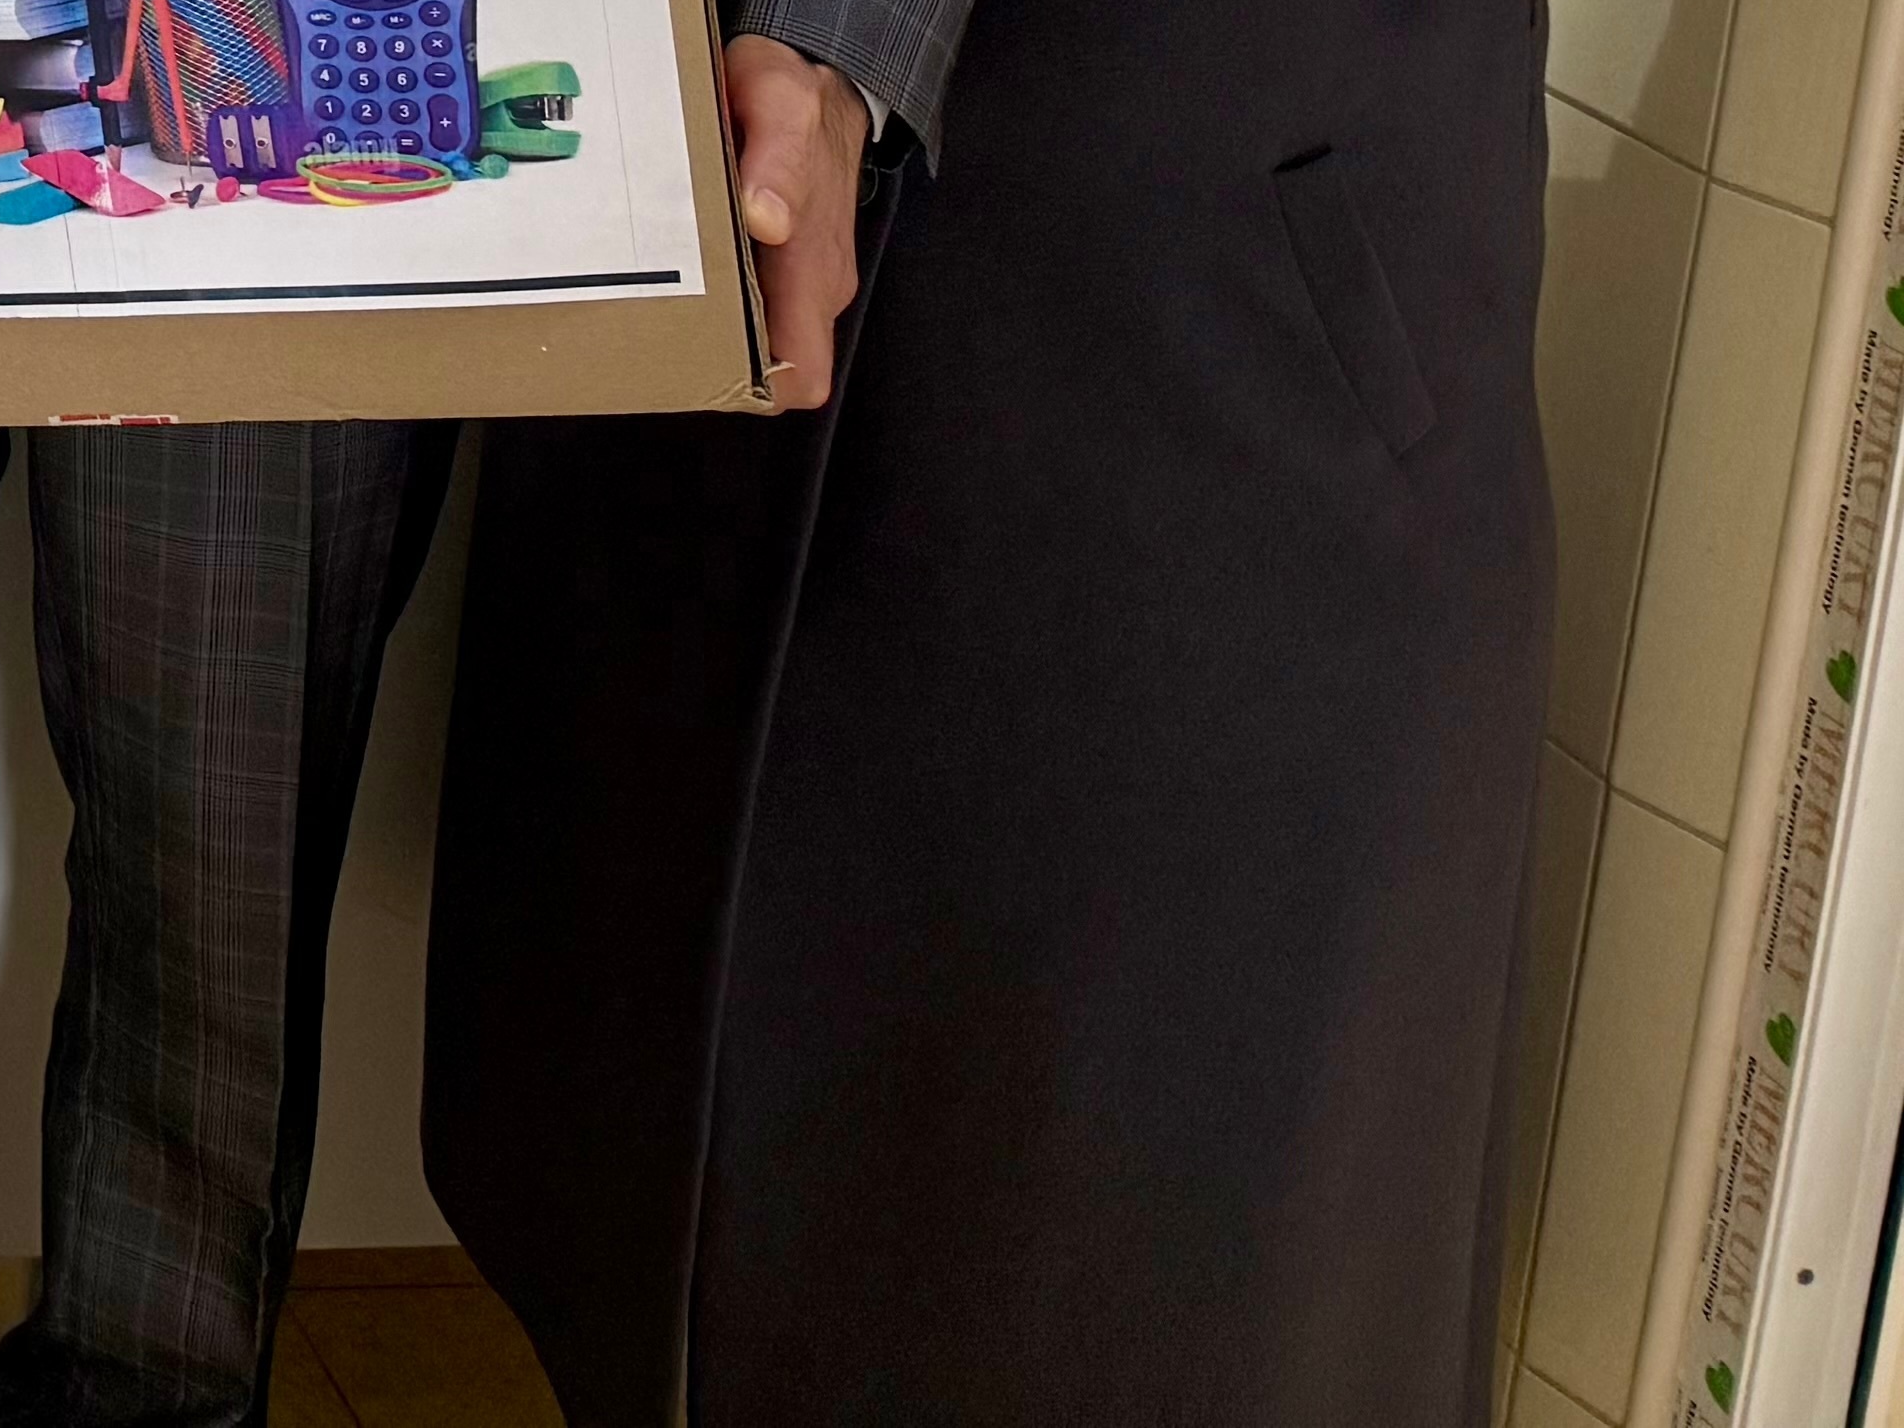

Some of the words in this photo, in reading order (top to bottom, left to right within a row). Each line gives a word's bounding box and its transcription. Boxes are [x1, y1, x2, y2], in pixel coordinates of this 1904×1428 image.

[1853, 392, 1866, 415] by
[1839, 417, 1864, 500] German
[1821, 505, 1848, 615] technology
